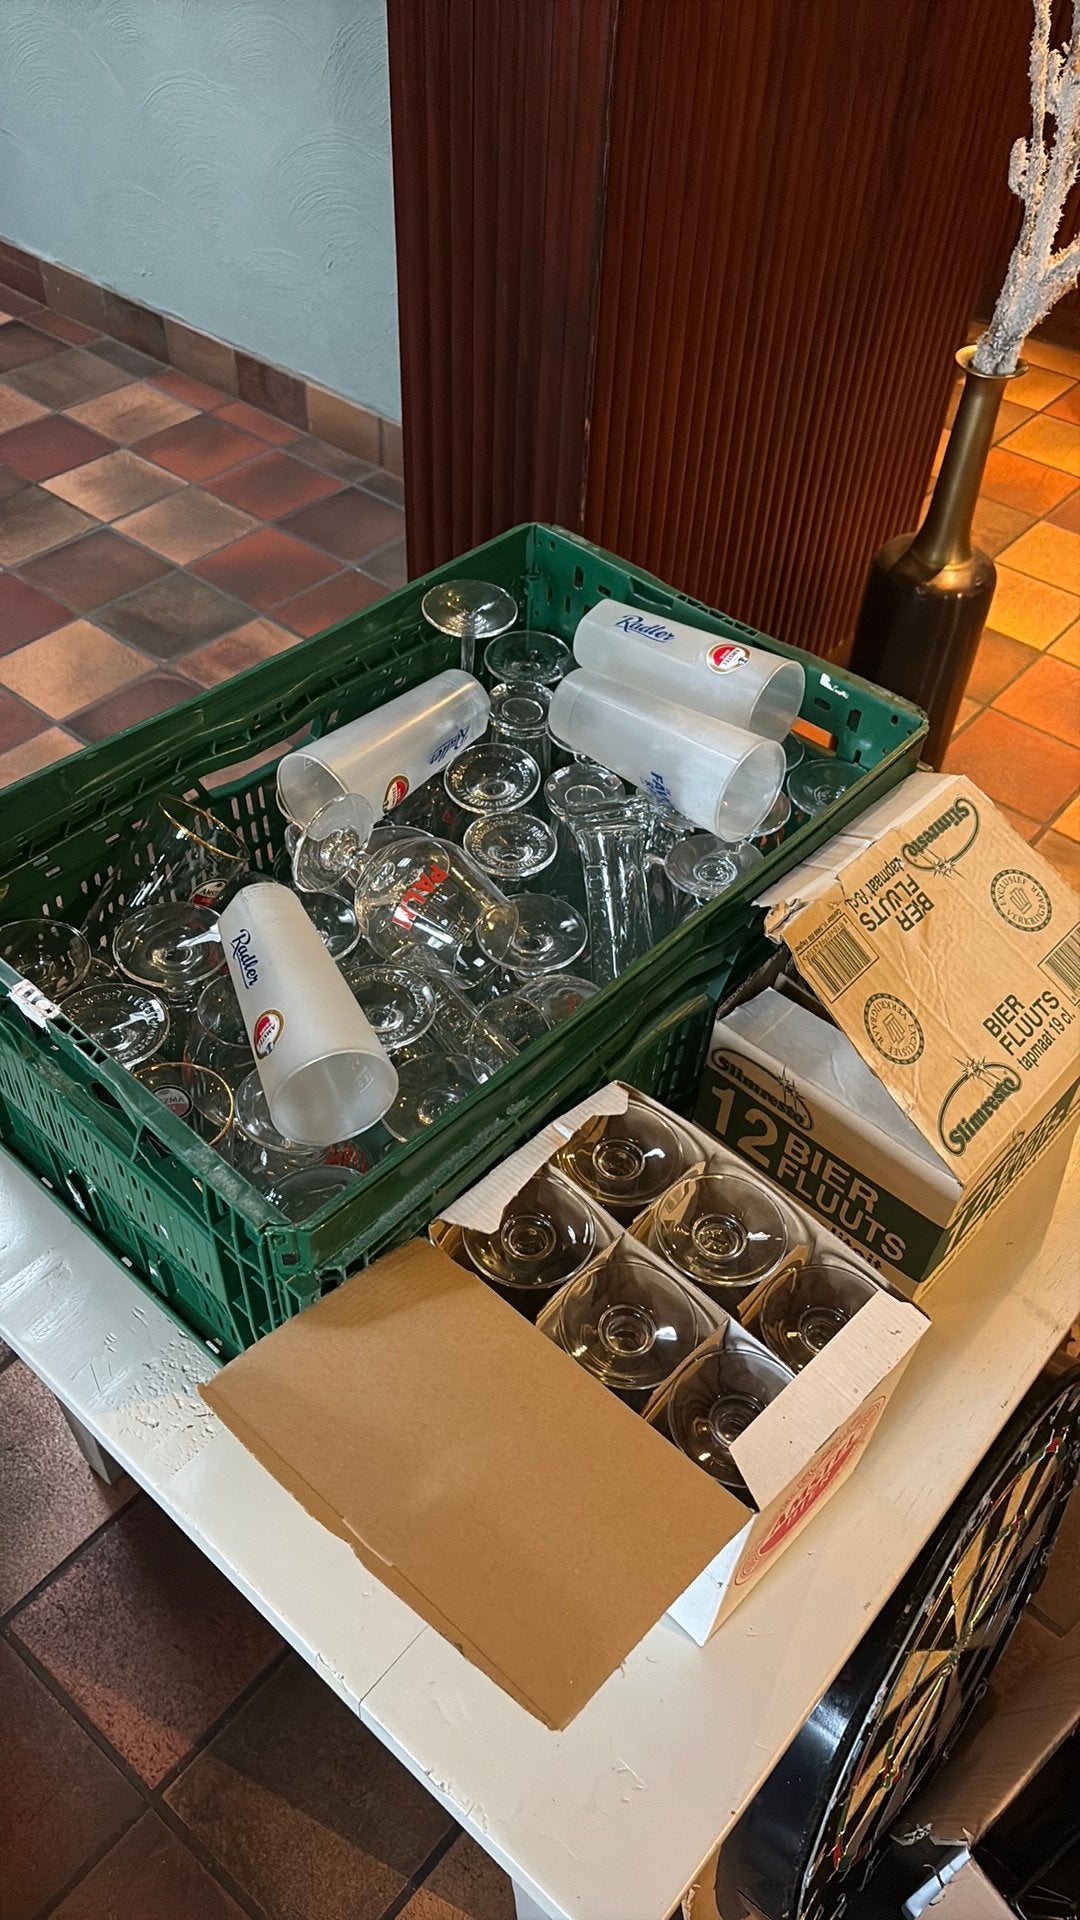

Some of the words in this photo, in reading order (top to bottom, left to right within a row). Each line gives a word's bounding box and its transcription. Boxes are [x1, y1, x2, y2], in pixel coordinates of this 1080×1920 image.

[615, 614, 675, 644] Radler
[904, 800, 970, 857] Slimresto
[391, 863, 449, 931] PALM
[895, 891, 935, 932] BIER
[997, 875, 1027, 906] EXCLUSIEF
[1007, 884, 1046, 925] VERKRIJGBAAR
[229, 928, 260, 990] Radler
[870, 1000, 907, 1045] VERKRIJGBAAR
[888, 1023, 917, 1057] EXCLUSIEF
[982, 993, 1025, 1039] BIER
[998, 990, 1060, 1057] FLUUTS
[1016, 1029, 1057, 1072] tapmaat
[1049, 1015, 1066, 1036] 19
[1061, 1006, 1077, 1026] cl.
[948, 1075, 1019, 1149] Slimresto
[711, 1085, 779, 1168] 12
[783, 1131, 879, 1216] BIER
[776, 1158, 908, 1262] FLUUTS
